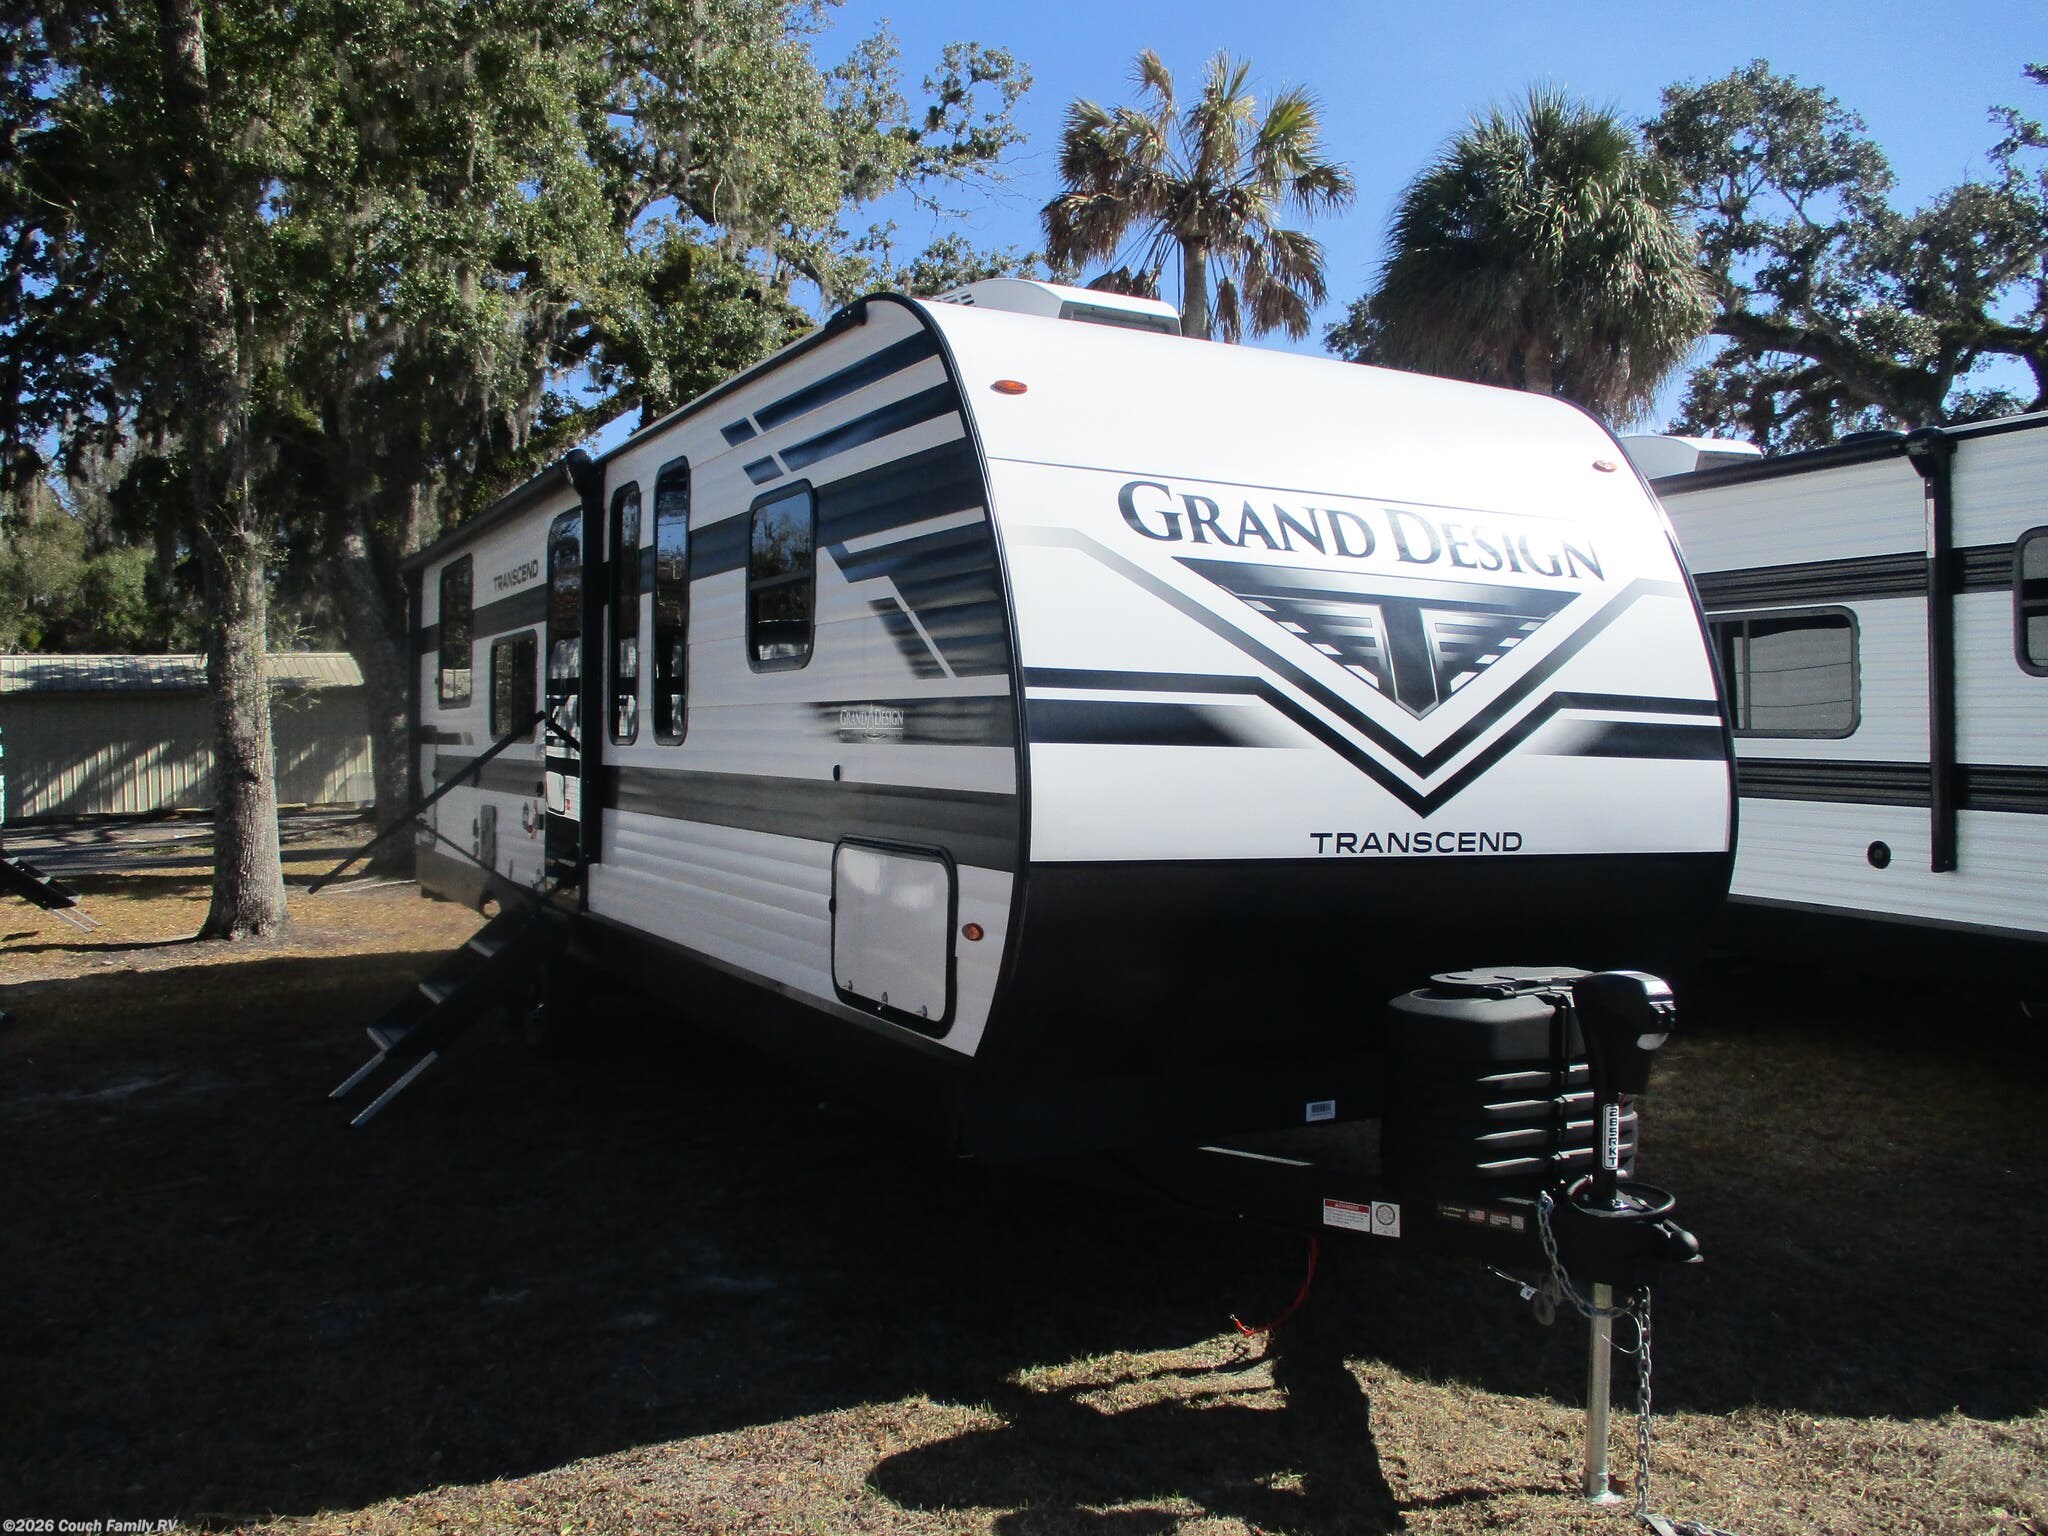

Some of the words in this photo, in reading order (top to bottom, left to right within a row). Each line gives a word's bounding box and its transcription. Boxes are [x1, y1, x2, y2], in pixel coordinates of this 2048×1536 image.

[1117, 480, 1376, 558] GRAND
[1381, 507, 1605, 582] DESIGN
[492, 559, 539, 593] TRANSCEND
[840, 709, 867, 726] GRAND
[874, 708, 904, 726] DESIGN
[1310, 831, 1523, 855] TRANSCEND
